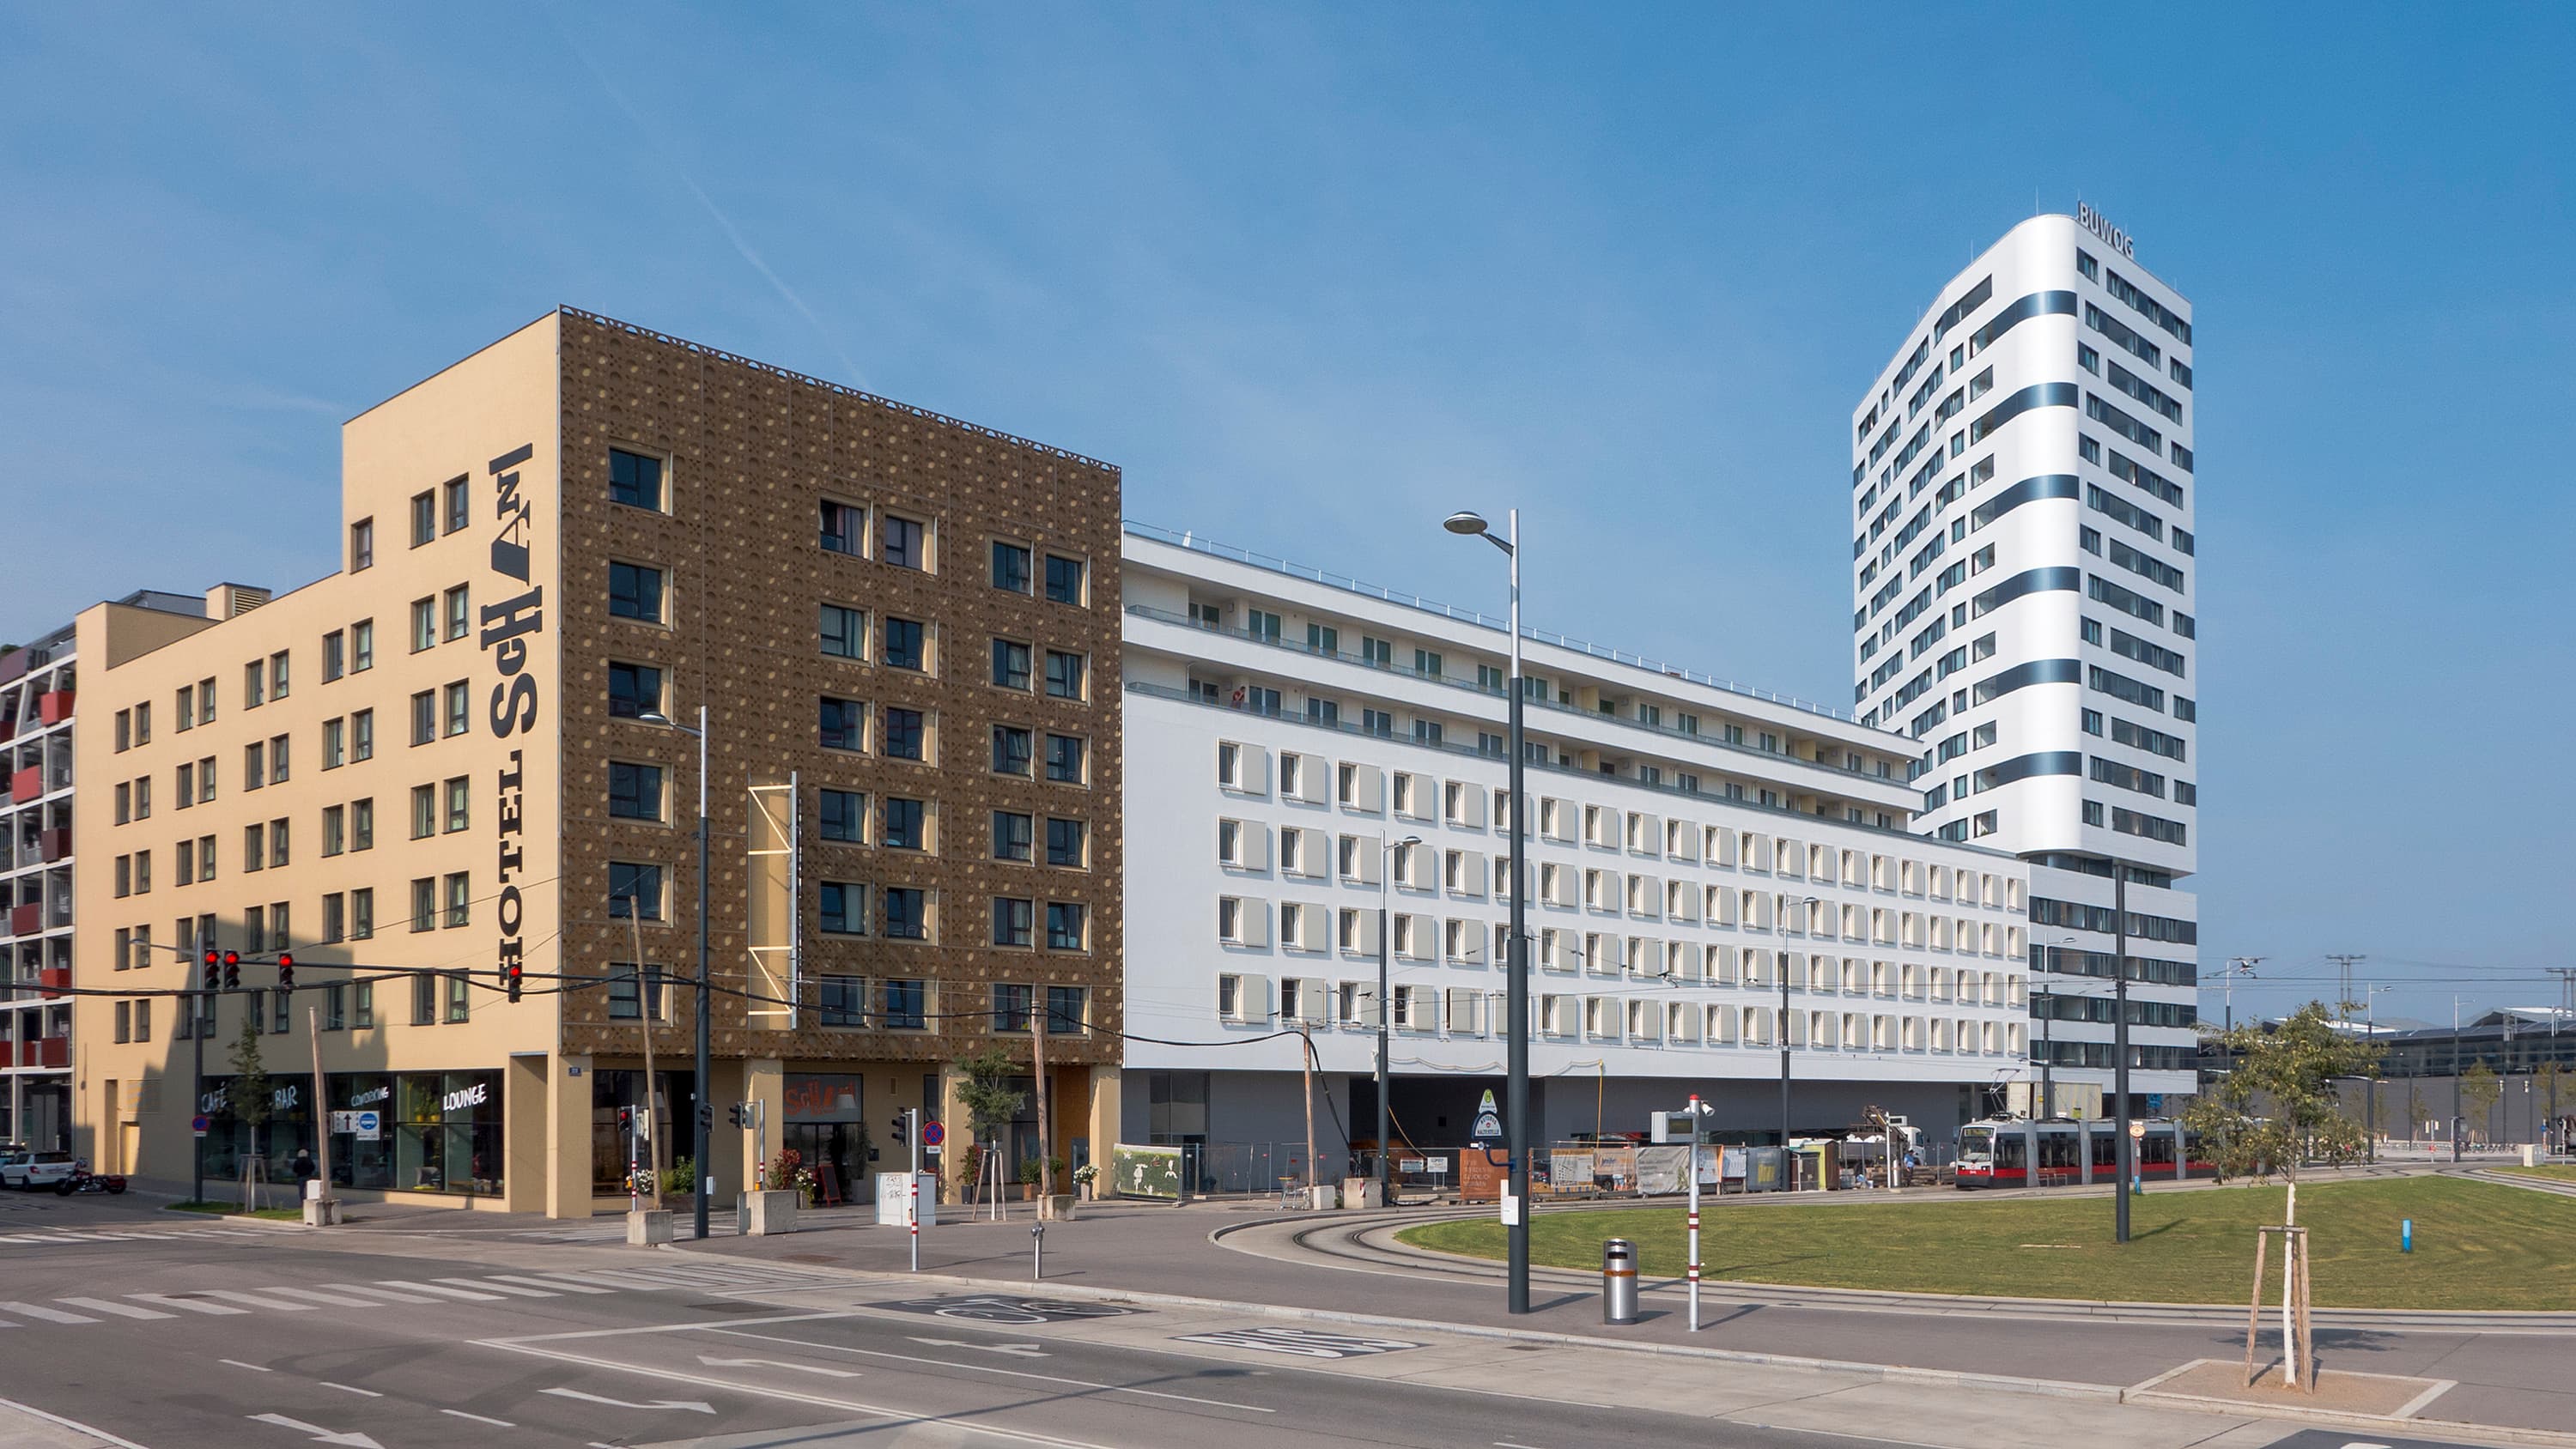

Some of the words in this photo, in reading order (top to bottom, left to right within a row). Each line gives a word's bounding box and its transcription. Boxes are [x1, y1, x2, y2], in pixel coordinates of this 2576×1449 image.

[2078, 200, 2134, 260] BUWOG
[481, 442, 543, 739] SCHANI
[498, 749, 522, 986] HOTEL
[201, 1081, 228, 1113] CAFÉ
[274, 1084, 299, 1110] BAR
[442, 1082, 489, 1112] LOUNGE
[1173, 1328, 1418, 1358] BUS
